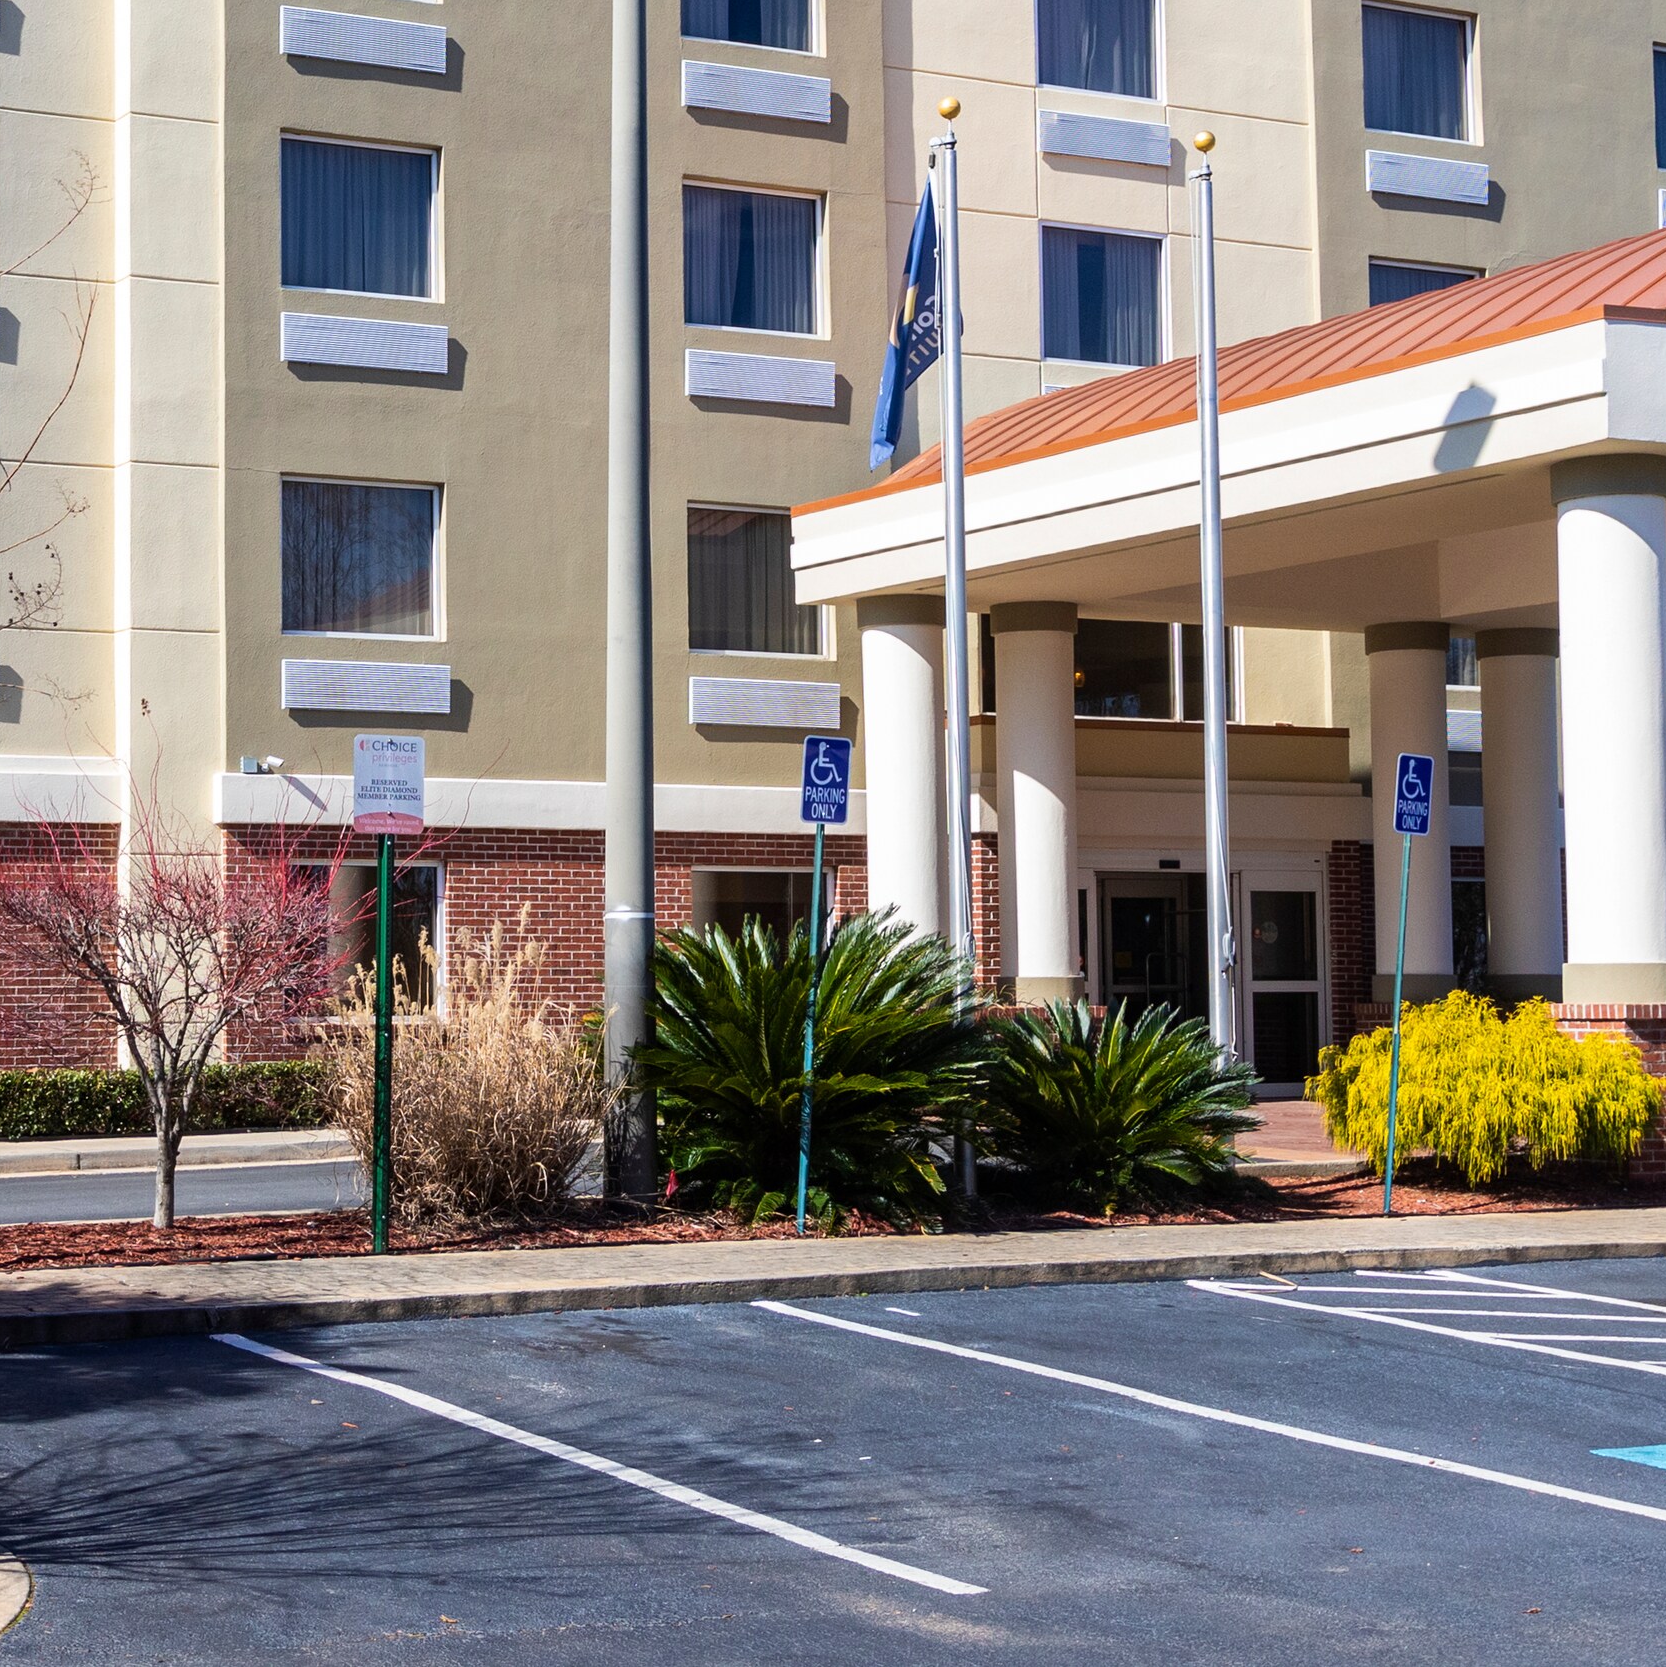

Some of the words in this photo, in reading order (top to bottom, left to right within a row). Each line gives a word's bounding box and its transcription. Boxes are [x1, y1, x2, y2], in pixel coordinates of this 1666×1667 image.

[372, 740, 417, 752] CHOICE
[372, 753, 418, 765] privileges
[805, 786, 845, 804] PARKING
[811, 803, 838, 819] ONLY
[1398, 799, 1428, 816] PARKING
[1402, 814, 1422, 830] ONLY
